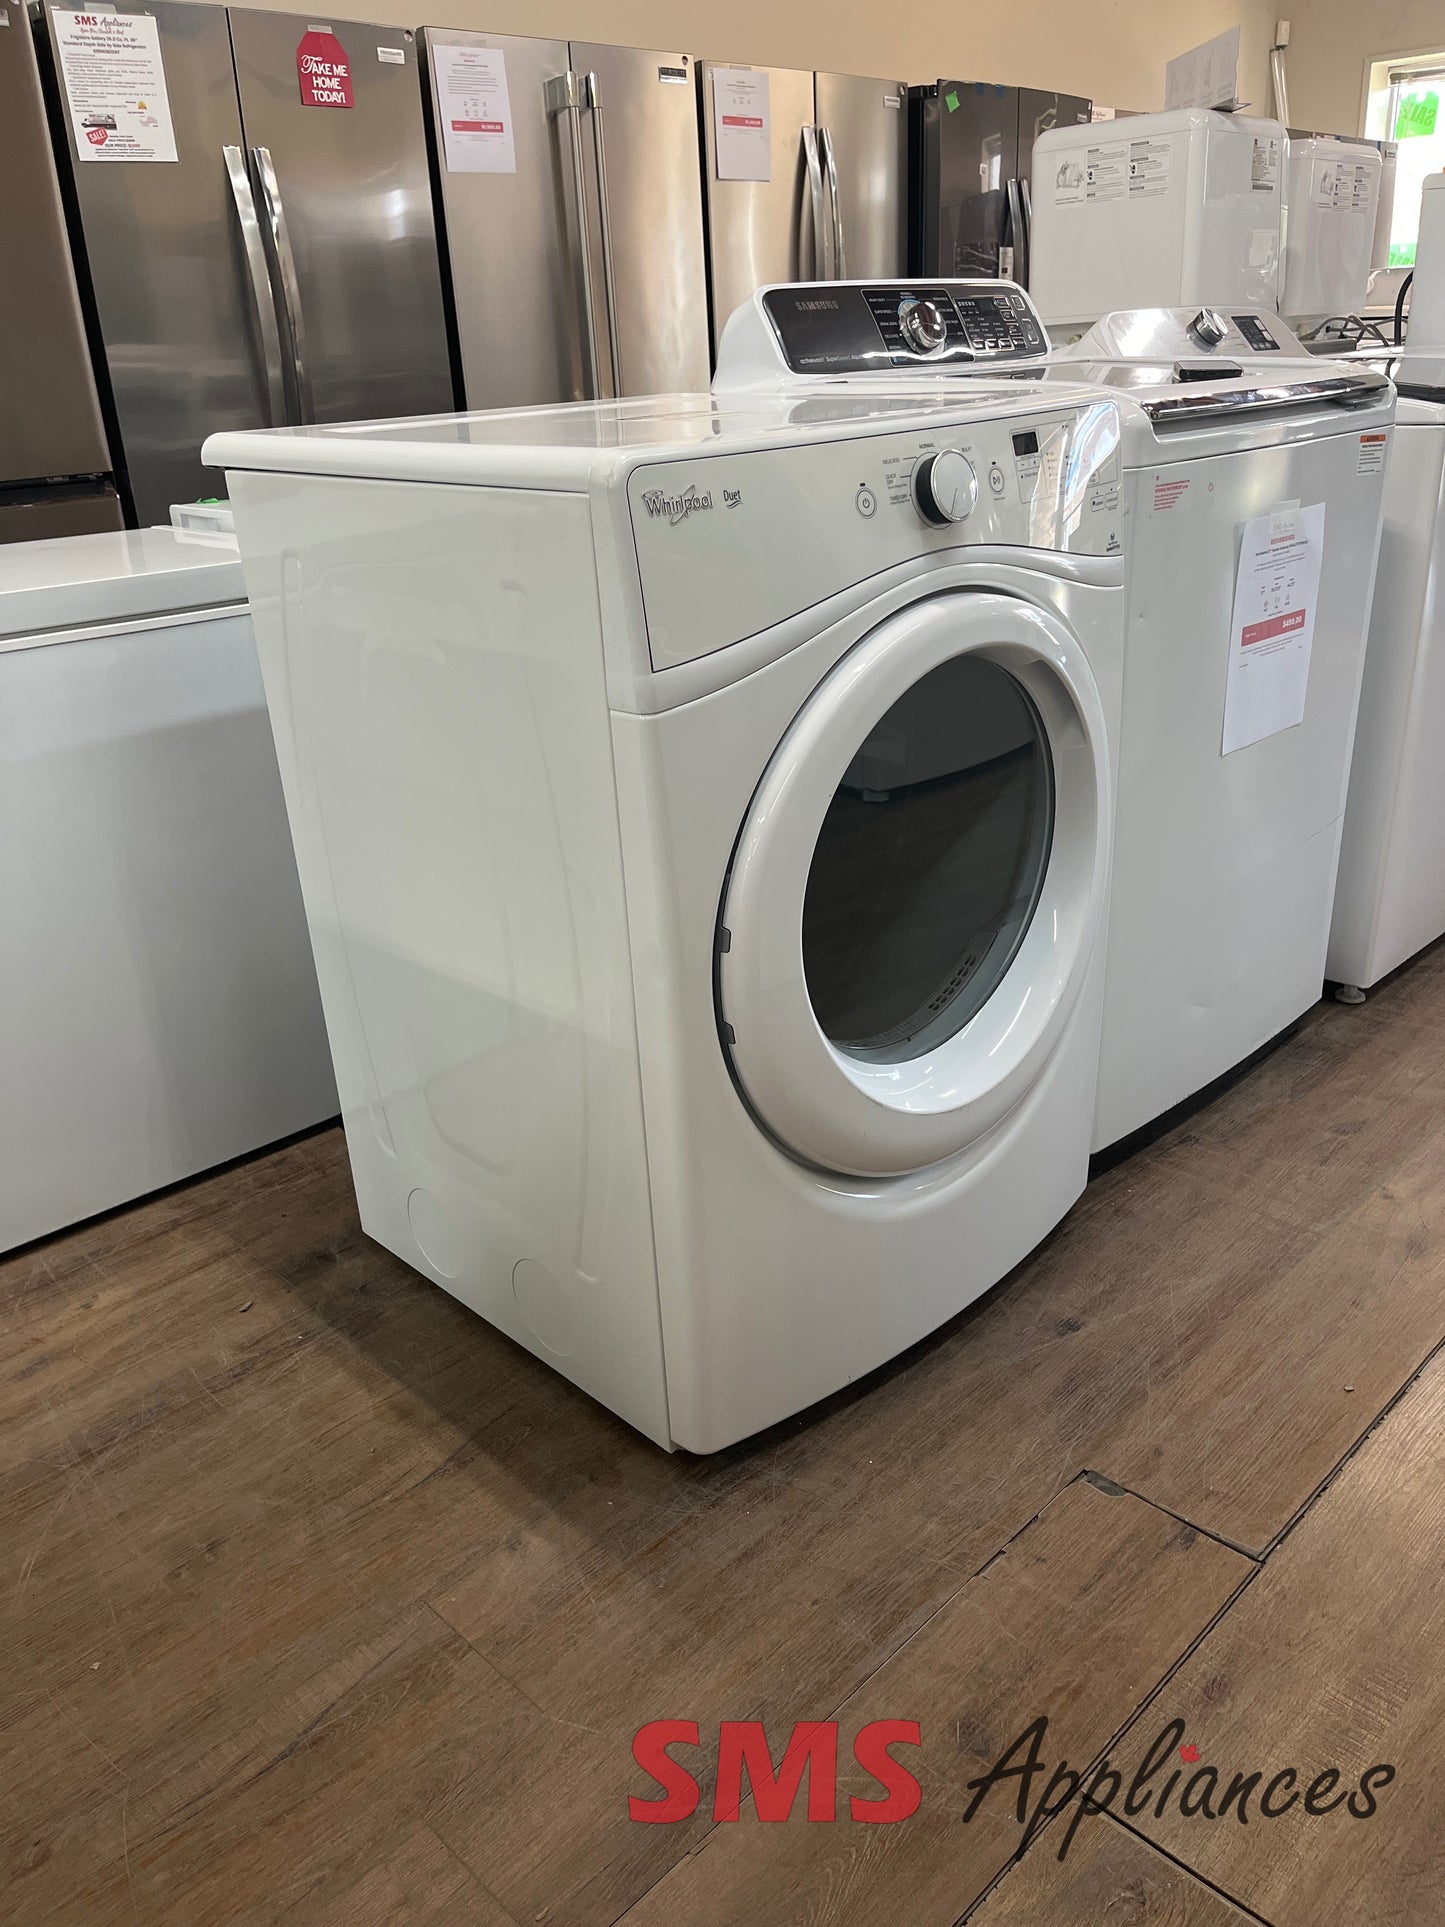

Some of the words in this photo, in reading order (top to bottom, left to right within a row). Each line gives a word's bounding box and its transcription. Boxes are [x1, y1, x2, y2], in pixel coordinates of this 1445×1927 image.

[74, 15, 98, 27] SMS
[100, 17, 133, 28] Appliances
[333, 64, 348, 77] ME
[313, 76, 342, 90] HOME
[311, 90, 346, 104] TODAY!
[88, 129, 107, 143] SALE!
[795, 300, 839, 311] SAMSUNG
[882, 457, 901, 465] DELICATES
[722, 489, 742, 501] Duet
[643, 490, 714, 519] Whirlpool
